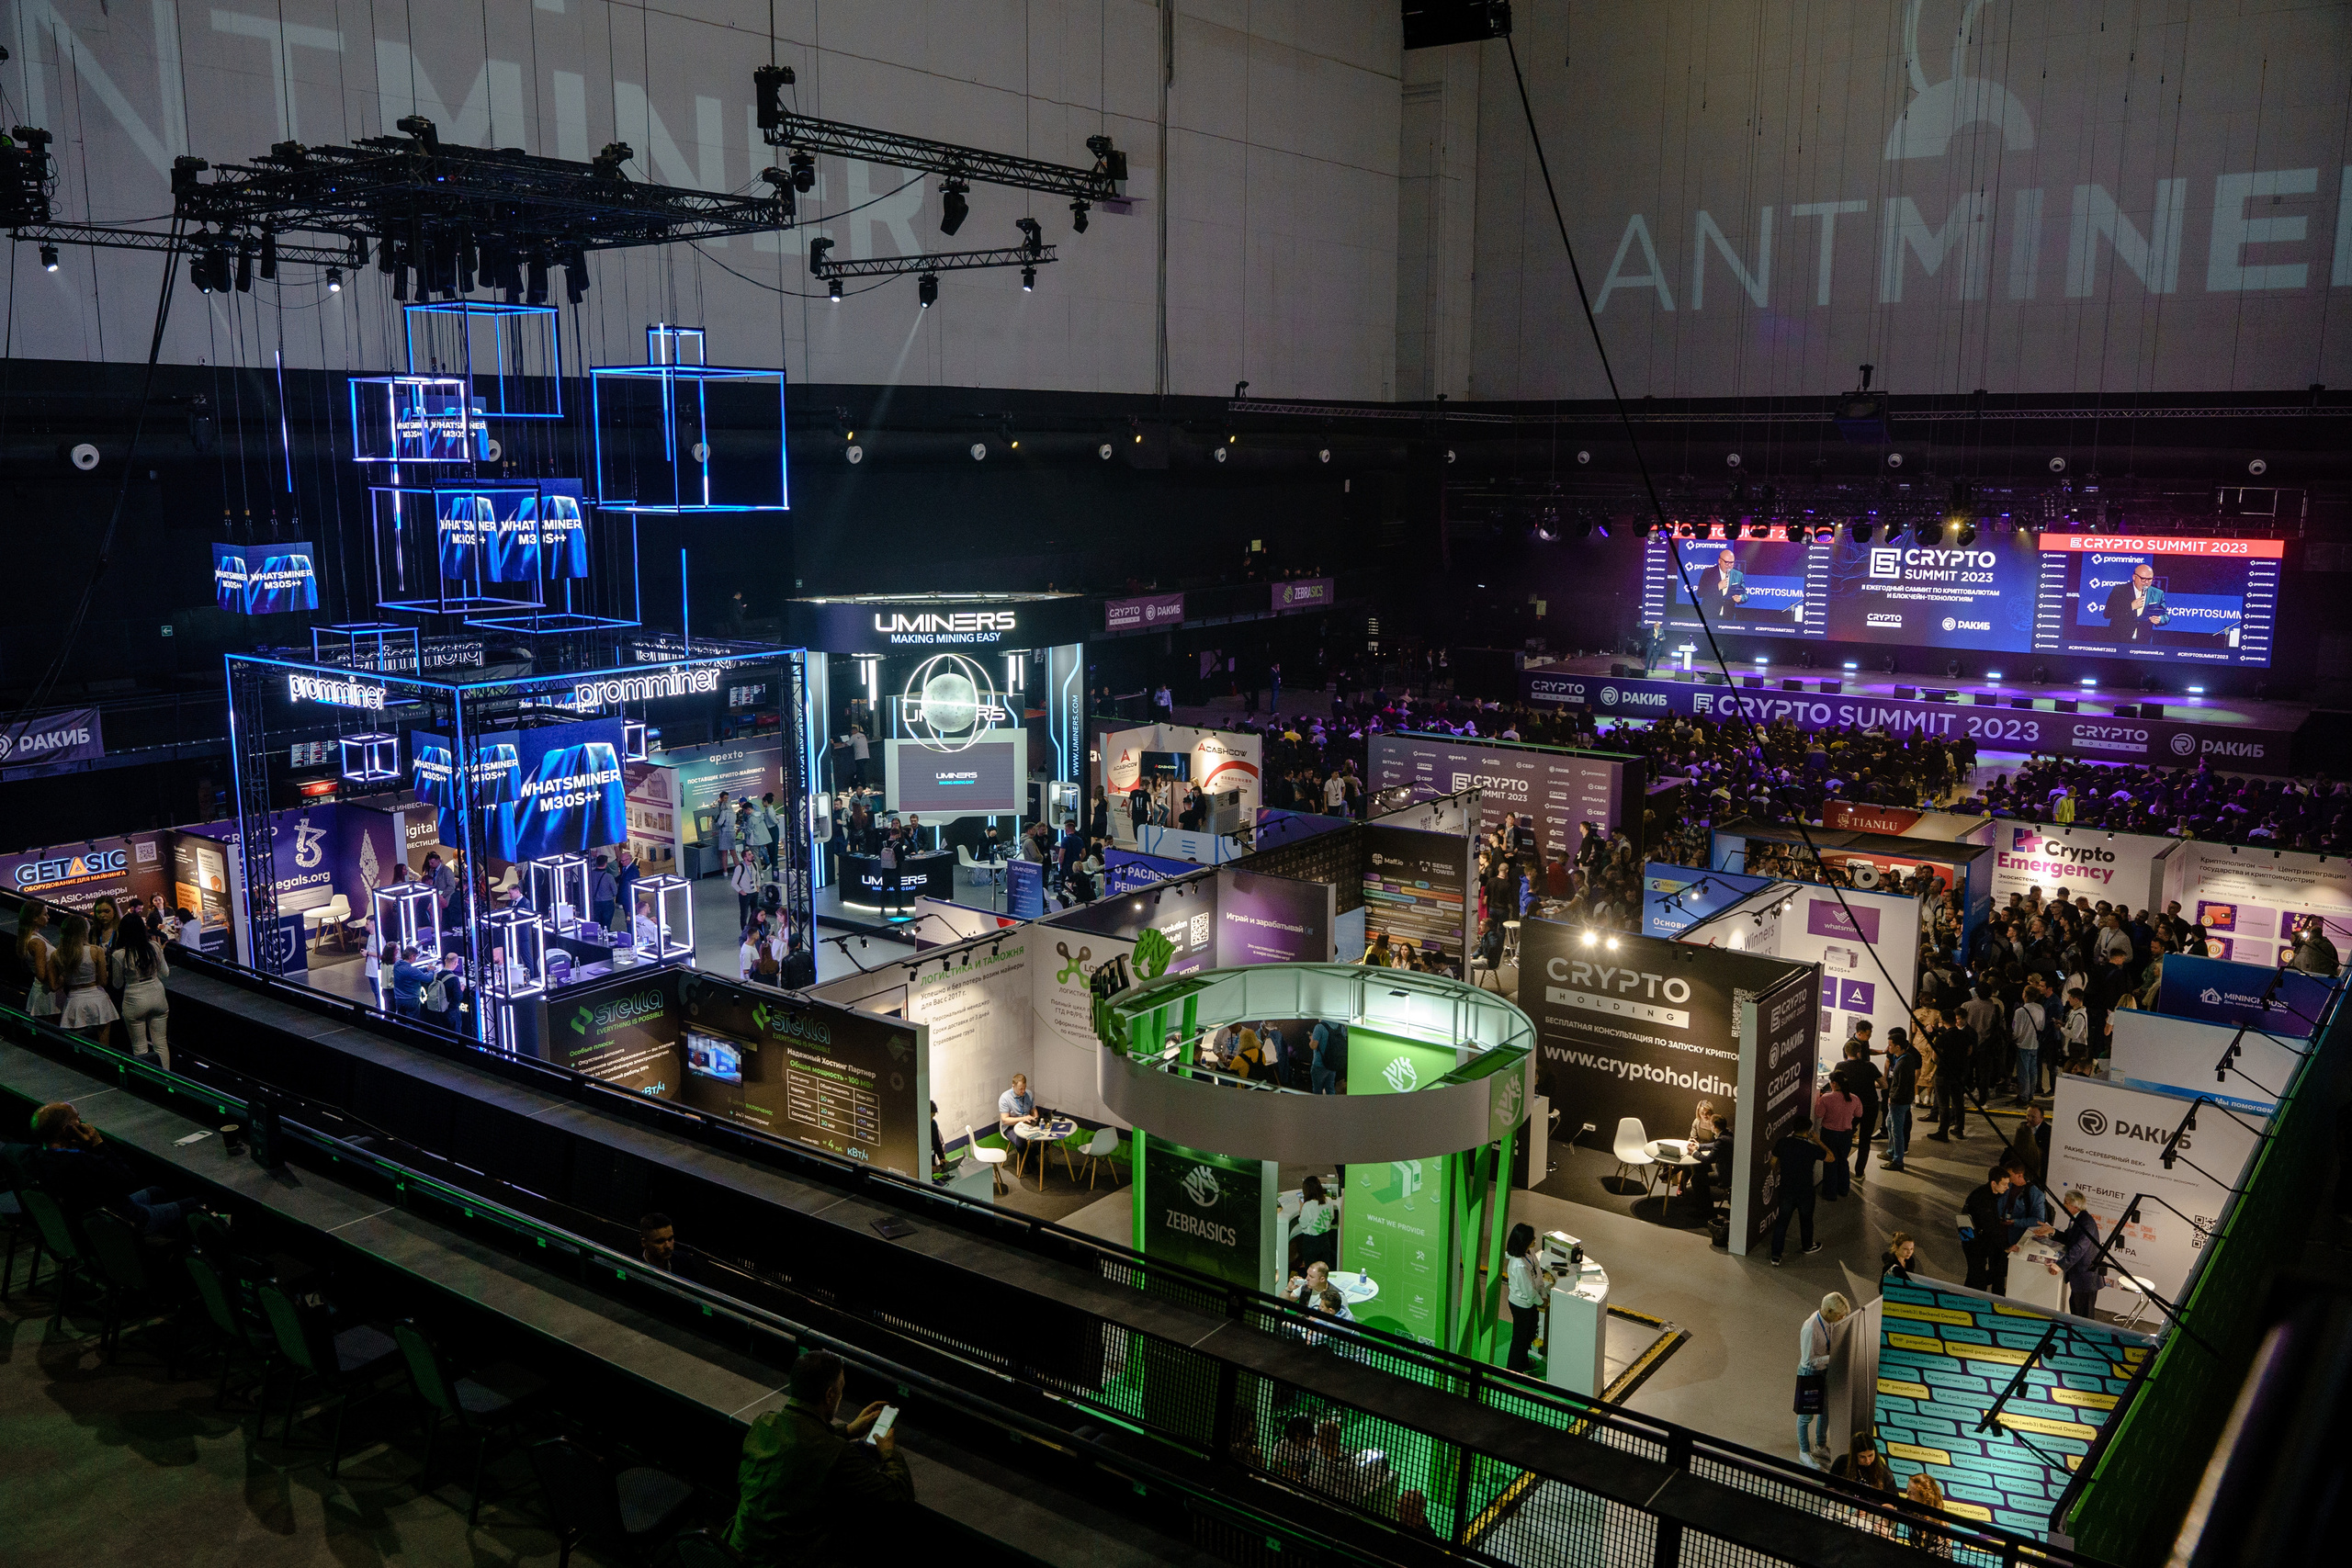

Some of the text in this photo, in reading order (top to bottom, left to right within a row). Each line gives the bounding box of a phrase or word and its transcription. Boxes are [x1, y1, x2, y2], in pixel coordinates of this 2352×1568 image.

[440, 520, 496, 531] WHATSMNER
[452, 534, 486, 545] M30S+
[518, 534, 567, 545] M3S++
[2084, 537, 2247, 554] CRYPTO SUMMIT 2023
[1905, 548, 1996, 569] CRYPTO
[2104, 555, 2145, 564] promminer
[215, 570, 248, 581] WHATSMINER
[251, 570, 312, 581] WHATSMINER
[1905, 569, 1994, 583] SUMMIT 2023
[222, 580, 243, 589] M30S++
[264, 581, 301, 590] M30S++
[1295, 585, 1323, 600] ZEBRASICS
[1866, 584, 1905, 592] ЕЖЕГОДНЫЙ
[1943, 588, 1999, 596] КРИПТОВАЛЮТАМ
[1893, 592, 1973, 603] БЛОКЧЕЙН-ТЕХНОЛОГИЯМ
[1109, 606, 1140, 617] CRYPTO
[1157, 604, 1181, 616] РАКИБ
[1867, 613, 1902, 622] CRYPTO
[875, 612, 1015, 632] UMINERS
[1958, 620, 1990, 630] РАКИБ
[891, 632, 1001, 643] MAKING MINING EASY
[288, 674, 386, 710] promminer
[575, 666, 720, 713] promminer
[1532, 681, 1586, 694] CRYPTO
[1623, 691, 1668, 706] РАКИБ
[1718, 695, 2039, 741] CRYPTO SUMMIT 2023
[20, 728, 90, 752] РАКИБ
[2073, 724, 2149, 741] CRYPTO
[1198, 743, 1247, 757] ACASHCOW
[2201, 739, 2263, 758] РАКИБ
[709, 750, 743, 765] apexto
[422, 770, 447, 783] M30S++
[520, 769, 621, 797] WHATSMINER
[687, 767, 765, 784] ПОСТАВЩИК КРИПТО-МАЙНИНГА
[1474, 774, 1529, 792] CRYPTO
[540, 791, 602, 812] M30S++
[1481, 790, 1528, 802] UMMIT 2023
[1852, 818, 1897, 831] TIANLU
[2045, 840, 2115, 863] Crypto
[17, 850, 129, 884] GETASIC
[1432, 863, 1453, 871] SENSE
[1997, 852, 2114, 885] Emergency
[2199, 856, 2346, 880] Криптополигон Центр интеграции
[2199, 865, 2244, 876] государства
[2251, 872, 2315, 884] криптоиндустрии
[24, 879, 76, 892] ОБОРУДОВАНИЕ
[91, 871, 126, 881] МАЙНИНГА
[1998, 874, 2039, 883] Экосистема
[61, 886, 128, 905] ASIC-майнеры
[1160, 920, 1188, 935] Evolution
[1227, 912, 1249, 924] Играй
[1256, 919, 1304, 933] зарабатывай
[1745, 924, 1775, 950] Winners
[921, 946, 1024, 987] ЛОГИСТИКА И ТАМОЖНЯ
[921, 987, 945, 999] Успешно
[952, 982, 961, 990] без
[963, 976, 981, 987] потерь
[983, 971, 1000, 980] возим
[1001, 963, 1024, 974] майнеры
[1546, 957, 1690, 1003] CRYPTO
[922, 1002, 933, 1010] для
[933, 998, 943, 1006] Вас
[948, 991, 961, 1000] 2017
[1559, 992, 1674, 1021] HOLDING
[1781, 988, 1807, 1014] CRYPTO
[596, 1021, 631, 1035] EVERYTHING
[639, 1010, 664, 1022] POSSIBLE
[773, 1032, 802, 1047] EVERYTHING
[808, 1043, 831, 1054] POSSIBLE
[1545, 1016, 1704, 1055] БЕСПЛАТНАЯ КОНСУЛЬТАЦИЯ ПО ЗАПУСКУ
[1781, 1028, 1804, 1057] РАКИБ
[570, 1046, 593, 1057] Особые
[787, 1048, 876, 1079] Надежный Хостинг Партнер
[789, 1060, 874, 1089] Общая мощность 100 МВт
[1767, 1062, 1801, 1097] CRYPTO
[2115, 1120, 2192, 1150] РАКИБ
[2064, 1145, 2146, 1168] РАКИБ «СЕРЕБРЯНЫЙ ВЕК»
[2075, 1182, 2126, 1200] NFT-БИЛЕТ
[1166, 1209, 1237, 1247] ZEBRASICS
[1367, 1213, 1425, 1236] WHAT WE PROVIDE
[1940, 1314, 1967, 1322] Developer
[2004, 1337, 2023, 1345] Golang
[1974, 1349, 2008, 1359] разработчик
[2067, 1378, 2095, 1386] Аналитик
[1924, 1405, 1951, 1414] Blockchain
[2044, 1407, 2073, 1416] Developer
[1918, 1420, 1945, 1428] Developer
[2064, 1427, 2092, 1435] Developer
[1923, 1437, 1955, 1446] Разработчик
[2046, 1440, 2082, 1450] разработчик
[1968, 1459, 2019, 1472] Frontend Developer
[1959, 1507, 1986, 1517] Developer
